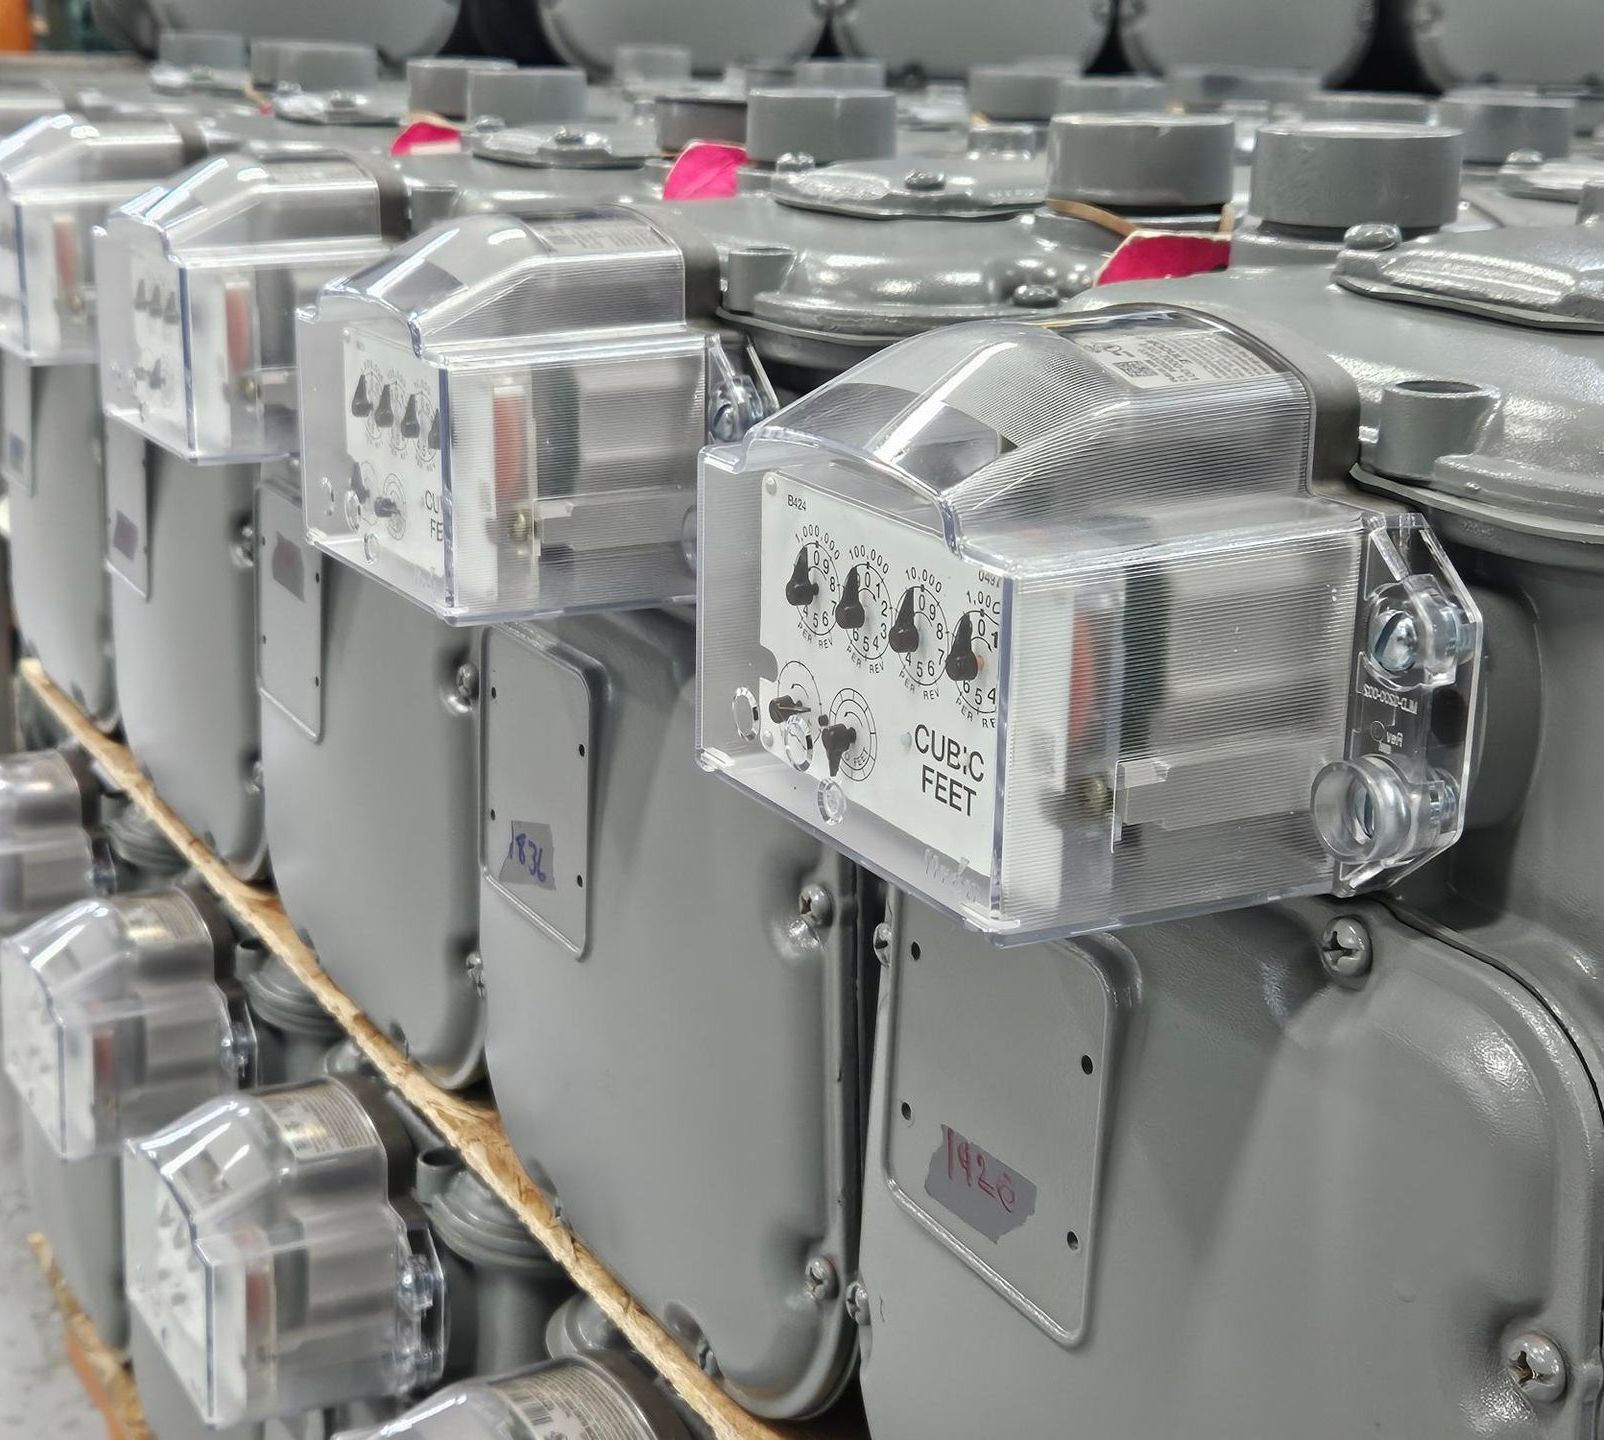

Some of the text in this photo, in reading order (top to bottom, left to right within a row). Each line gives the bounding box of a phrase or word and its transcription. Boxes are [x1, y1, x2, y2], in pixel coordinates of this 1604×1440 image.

[787, 494, 807, 511] B424
[795, 524, 840, 560] 1,000,000
[849, 545, 890, 574] 100,000
[905, 567, 942, 593] 10,000
[818, 638, 833, 650] REV
[869, 662, 884, 674] REV
[923, 688, 940, 701] REV
[914, 724, 985, 783] CUBIC
[922, 764, 977, 816] FEET
